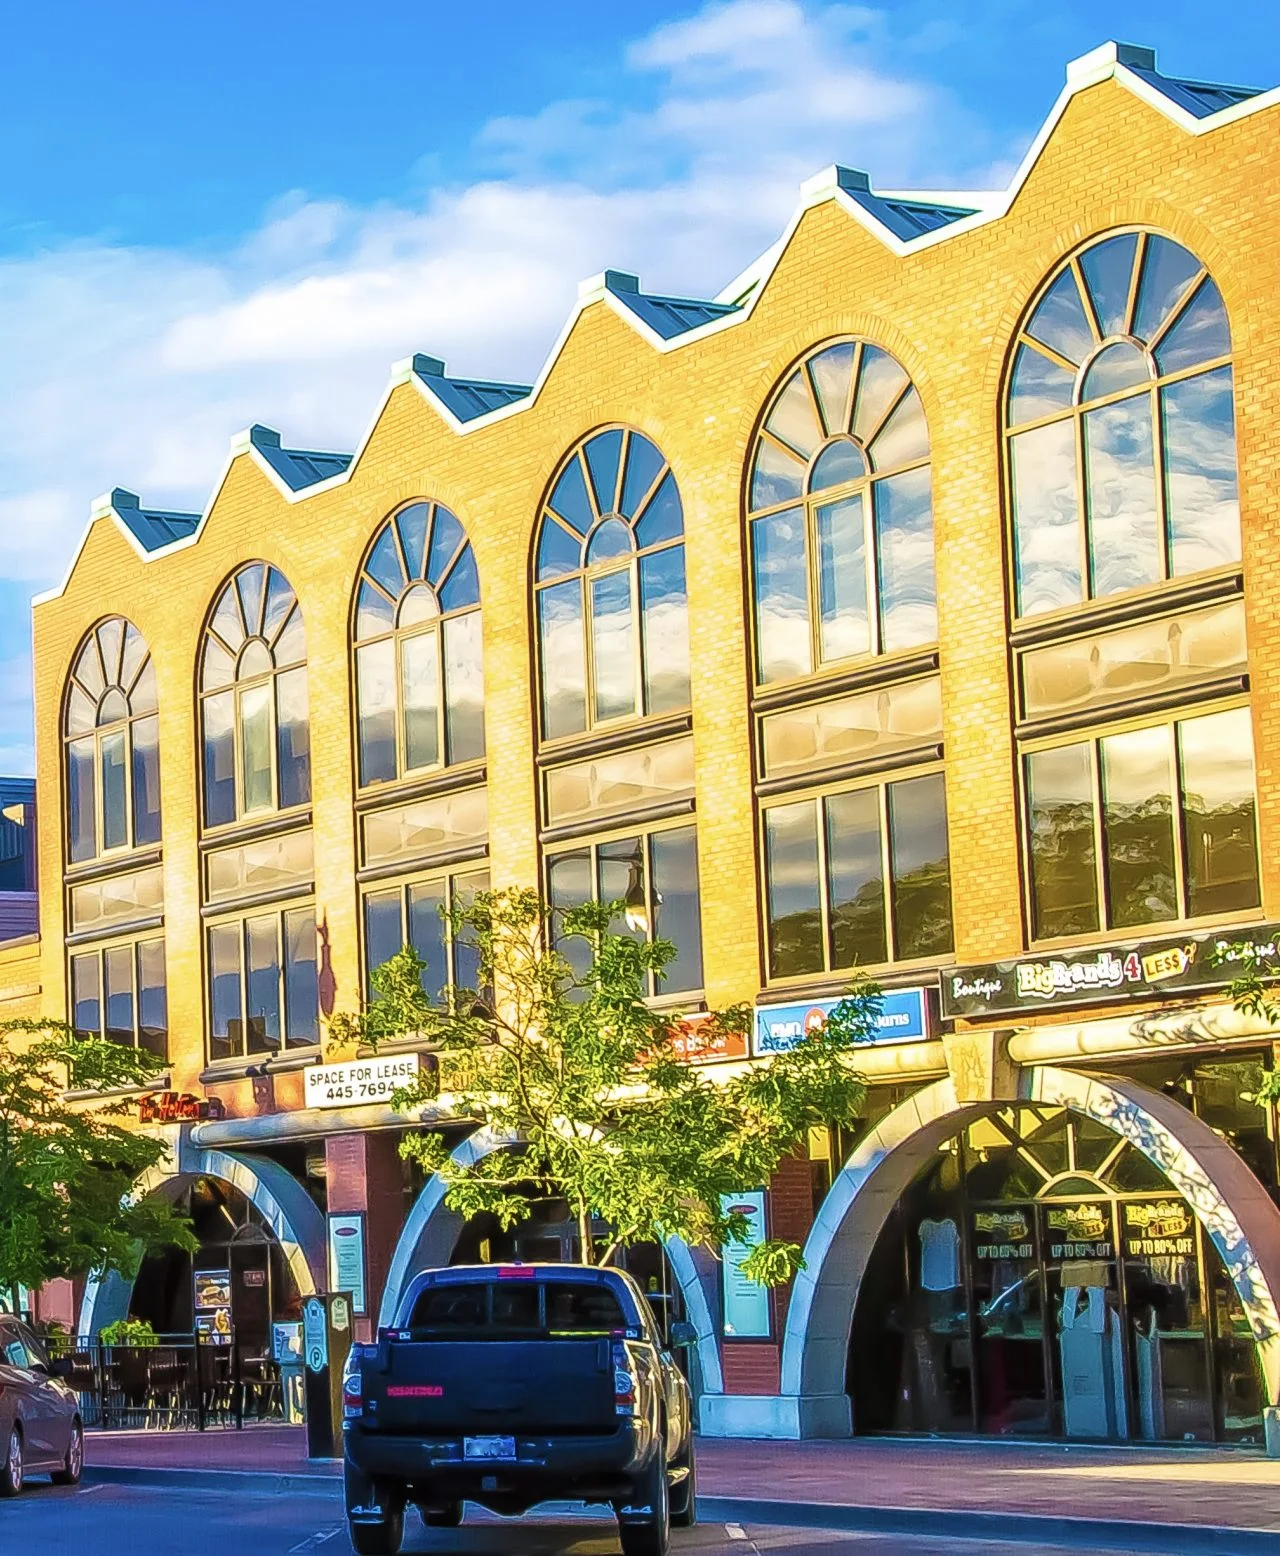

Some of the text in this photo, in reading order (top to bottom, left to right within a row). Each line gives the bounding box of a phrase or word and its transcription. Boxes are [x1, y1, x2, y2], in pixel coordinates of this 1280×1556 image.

[952, 977, 1002, 1001] Boutique
[1124, 955, 1140, 980] 4
[310, 1062, 413, 1087] SPACE FOR LEASE
[326, 1080, 396, 1100] 445-7694
[1063, 1244, 1074, 1257] TO
[1129, 1240, 1141, 1254] UP
[1142, 1240, 1153, 1254] TO
[1176, 1238, 1193, 1253] OFF
